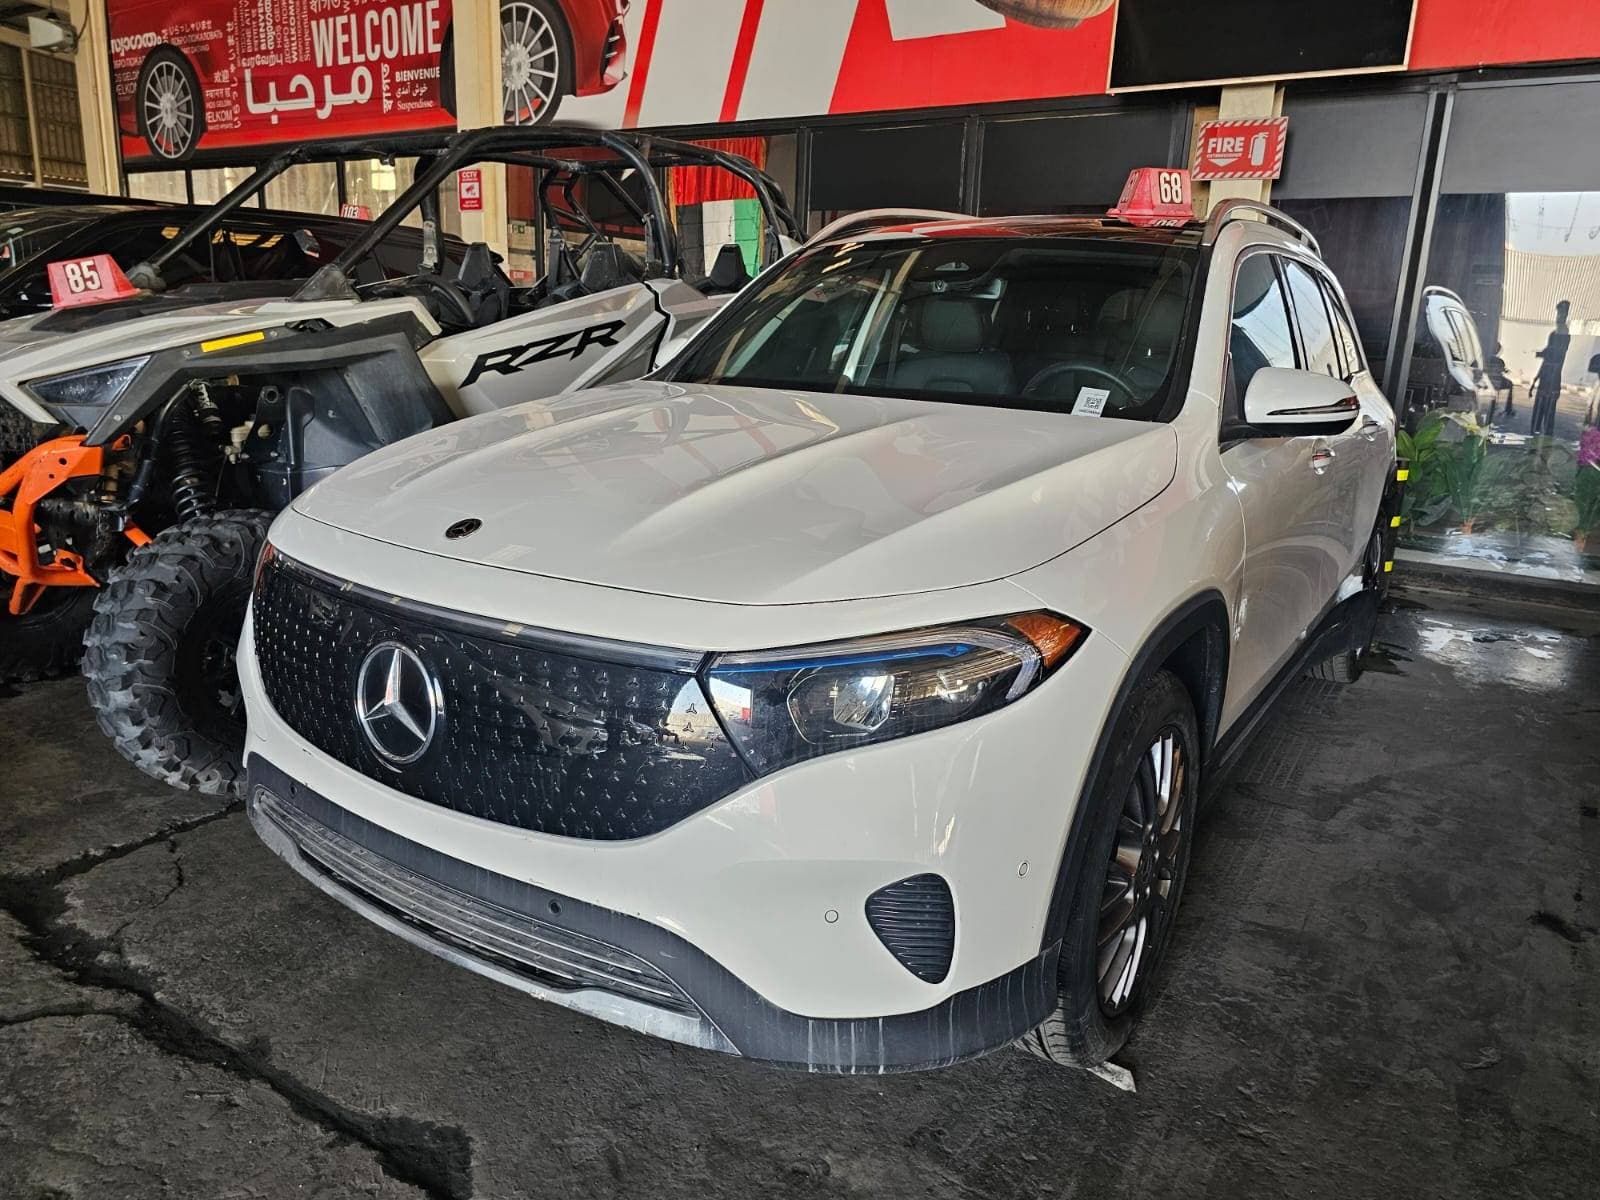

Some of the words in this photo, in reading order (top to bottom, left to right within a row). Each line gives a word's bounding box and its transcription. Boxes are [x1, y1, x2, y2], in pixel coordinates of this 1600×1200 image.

[310, 0, 441, 68] WELCOME
[395, 66, 441, 82] BIENVENUE
[244, 65, 374, 125] مرحبا
[1206, 136, 1246, 154] FIRE
[1159, 171, 1183, 205] 68
[343, 205, 359, 219] 103
[64, 260, 102, 294] 85
[457, 319, 627, 390] RZR
